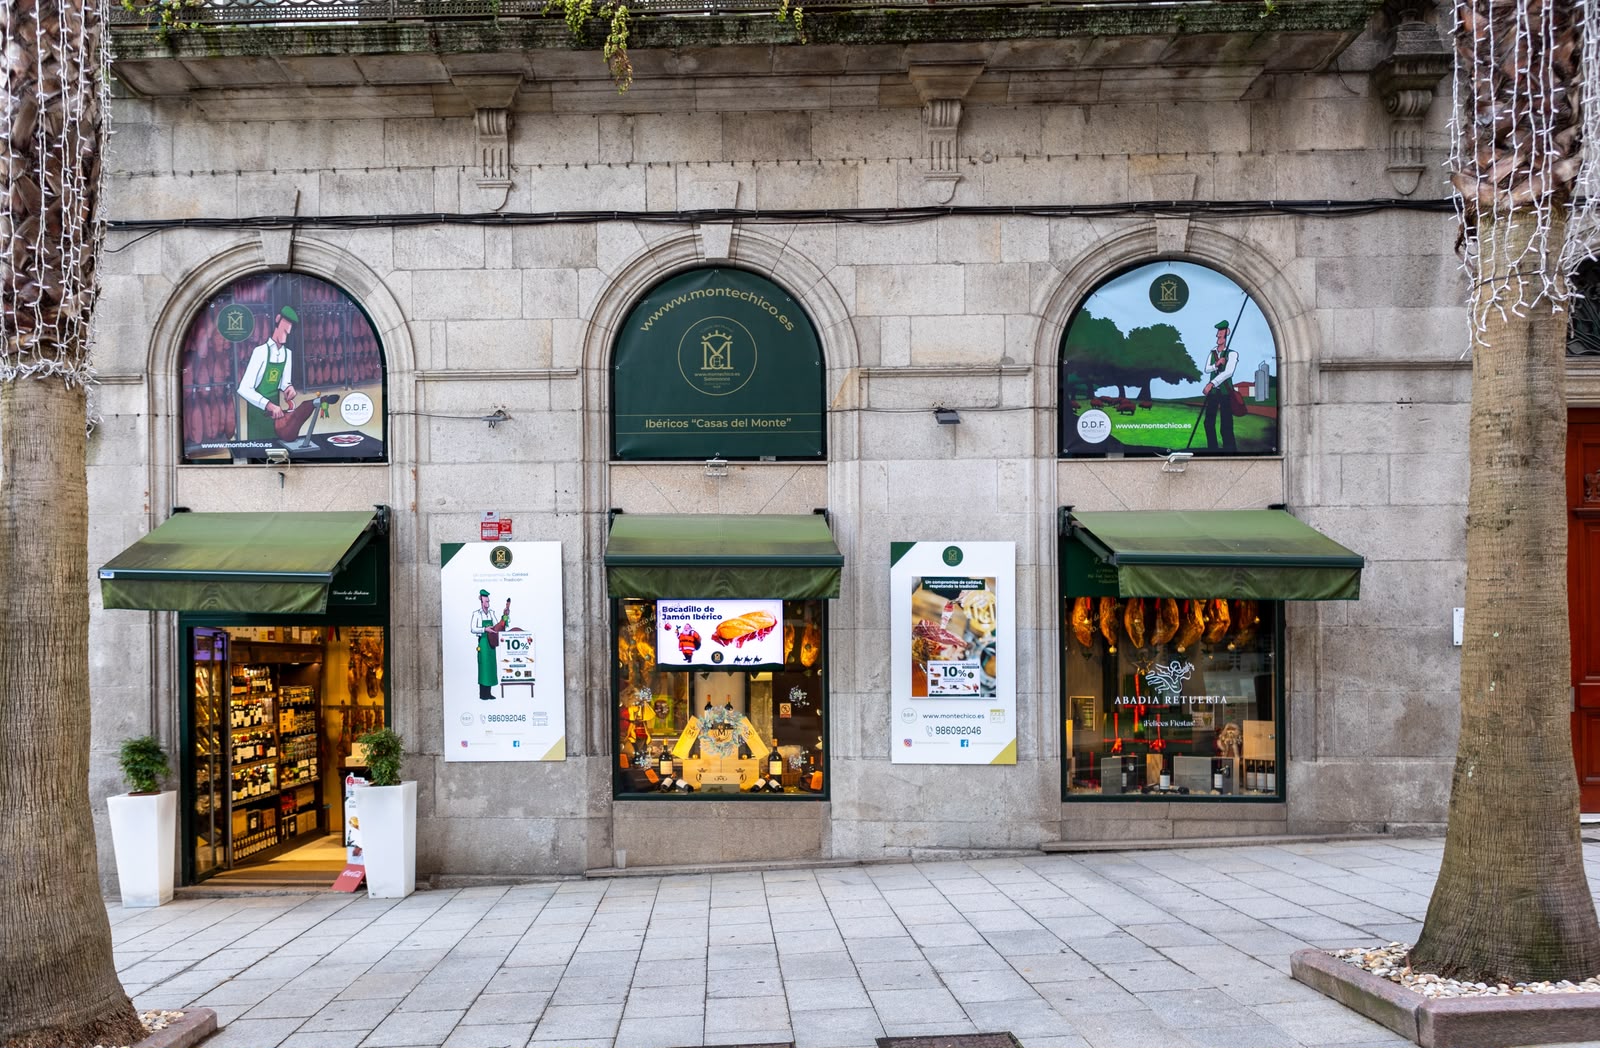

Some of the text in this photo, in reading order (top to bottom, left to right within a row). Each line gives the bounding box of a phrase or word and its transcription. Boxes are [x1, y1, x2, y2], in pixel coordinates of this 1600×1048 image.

[345, 403, 369, 411] D.D.F.
[645, 418, 689, 428] Ibéricos
[731, 418, 748, 428] del
[1081, 420, 1107, 429] D.D.F.
[661, 605, 715, 613] Bocadillo de
[661, 612, 723, 621] Jamón Ibérico
[505, 639, 530, 650] 10%
[942, 666, 967, 677] 10%
[1114, 695, 1227, 704] ABADIA RETUERTA
[487, 714, 527, 722] 986092046
[935, 726, 982, 735] 986092046
